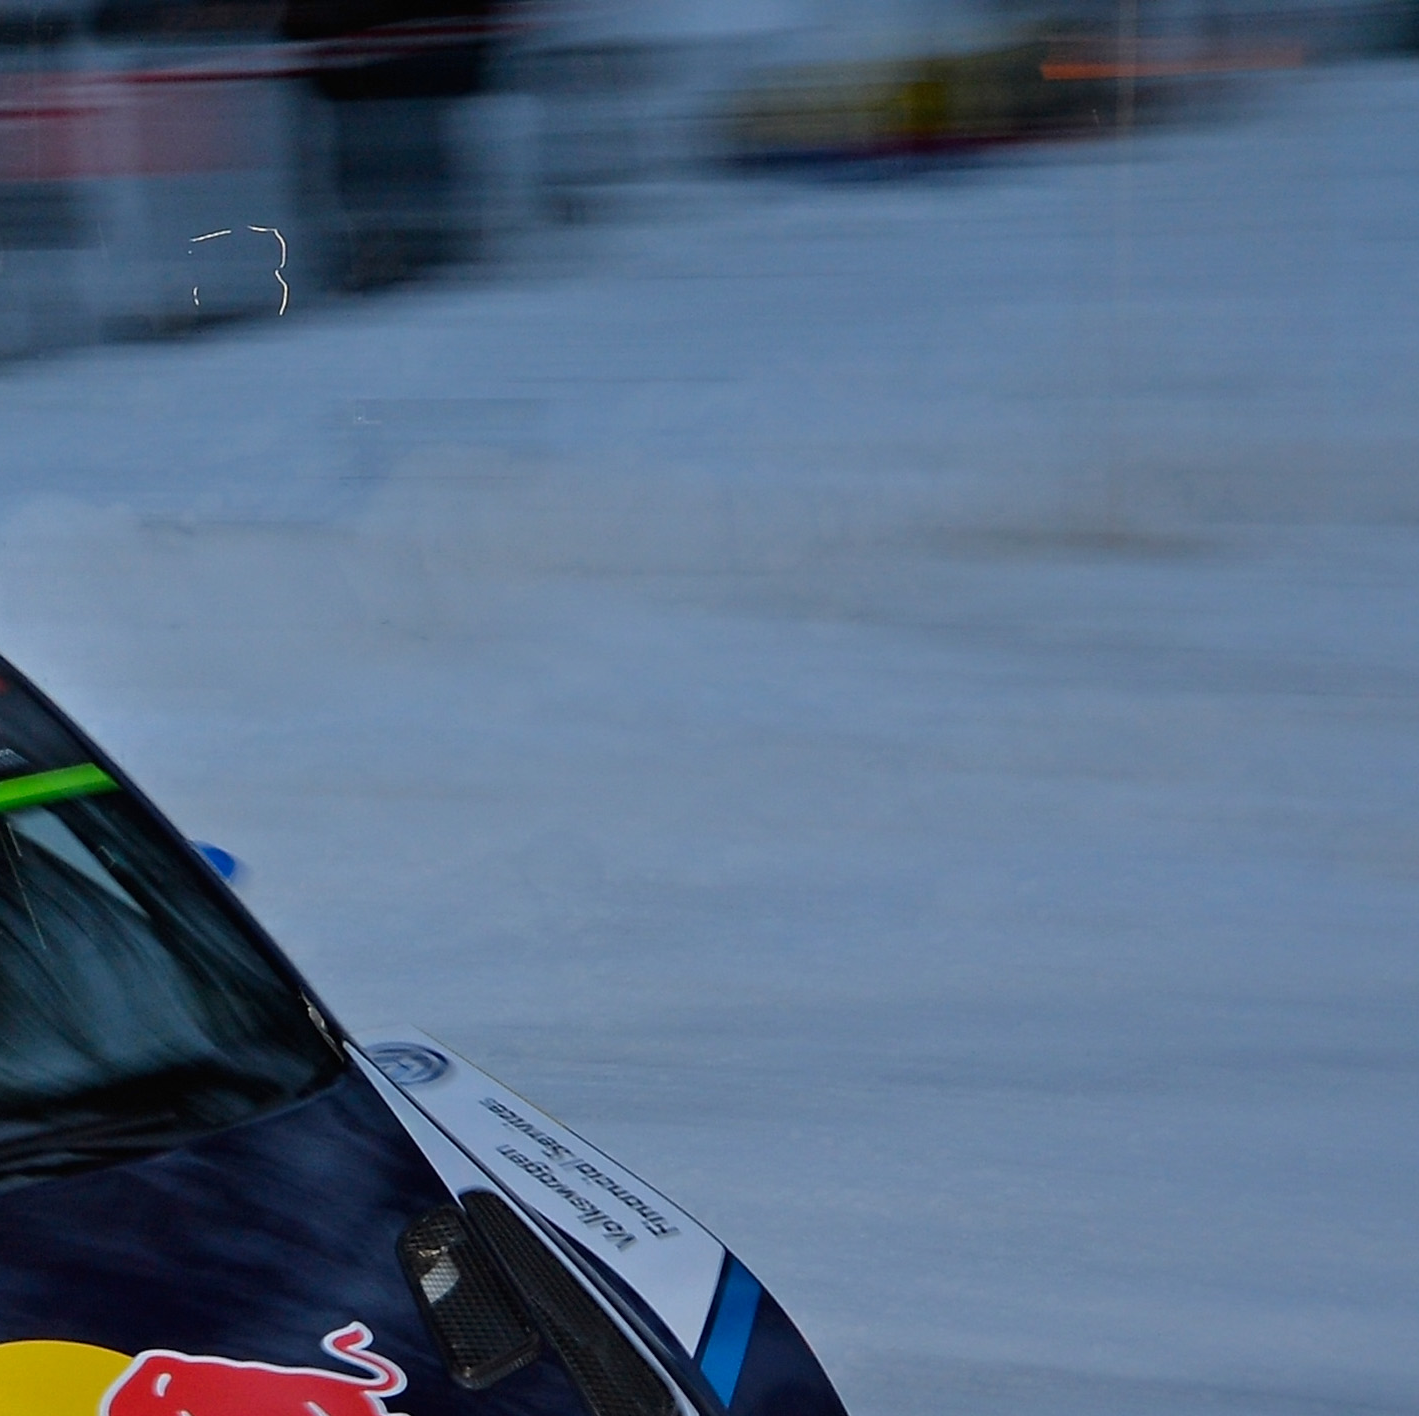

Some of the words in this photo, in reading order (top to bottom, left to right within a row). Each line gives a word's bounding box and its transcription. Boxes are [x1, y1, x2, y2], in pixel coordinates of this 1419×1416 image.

[478, 1097, 577, 1162] Services
[495, 1144, 639, 1252] Volkswagen
[560, 1158, 681, 1240] Financial
